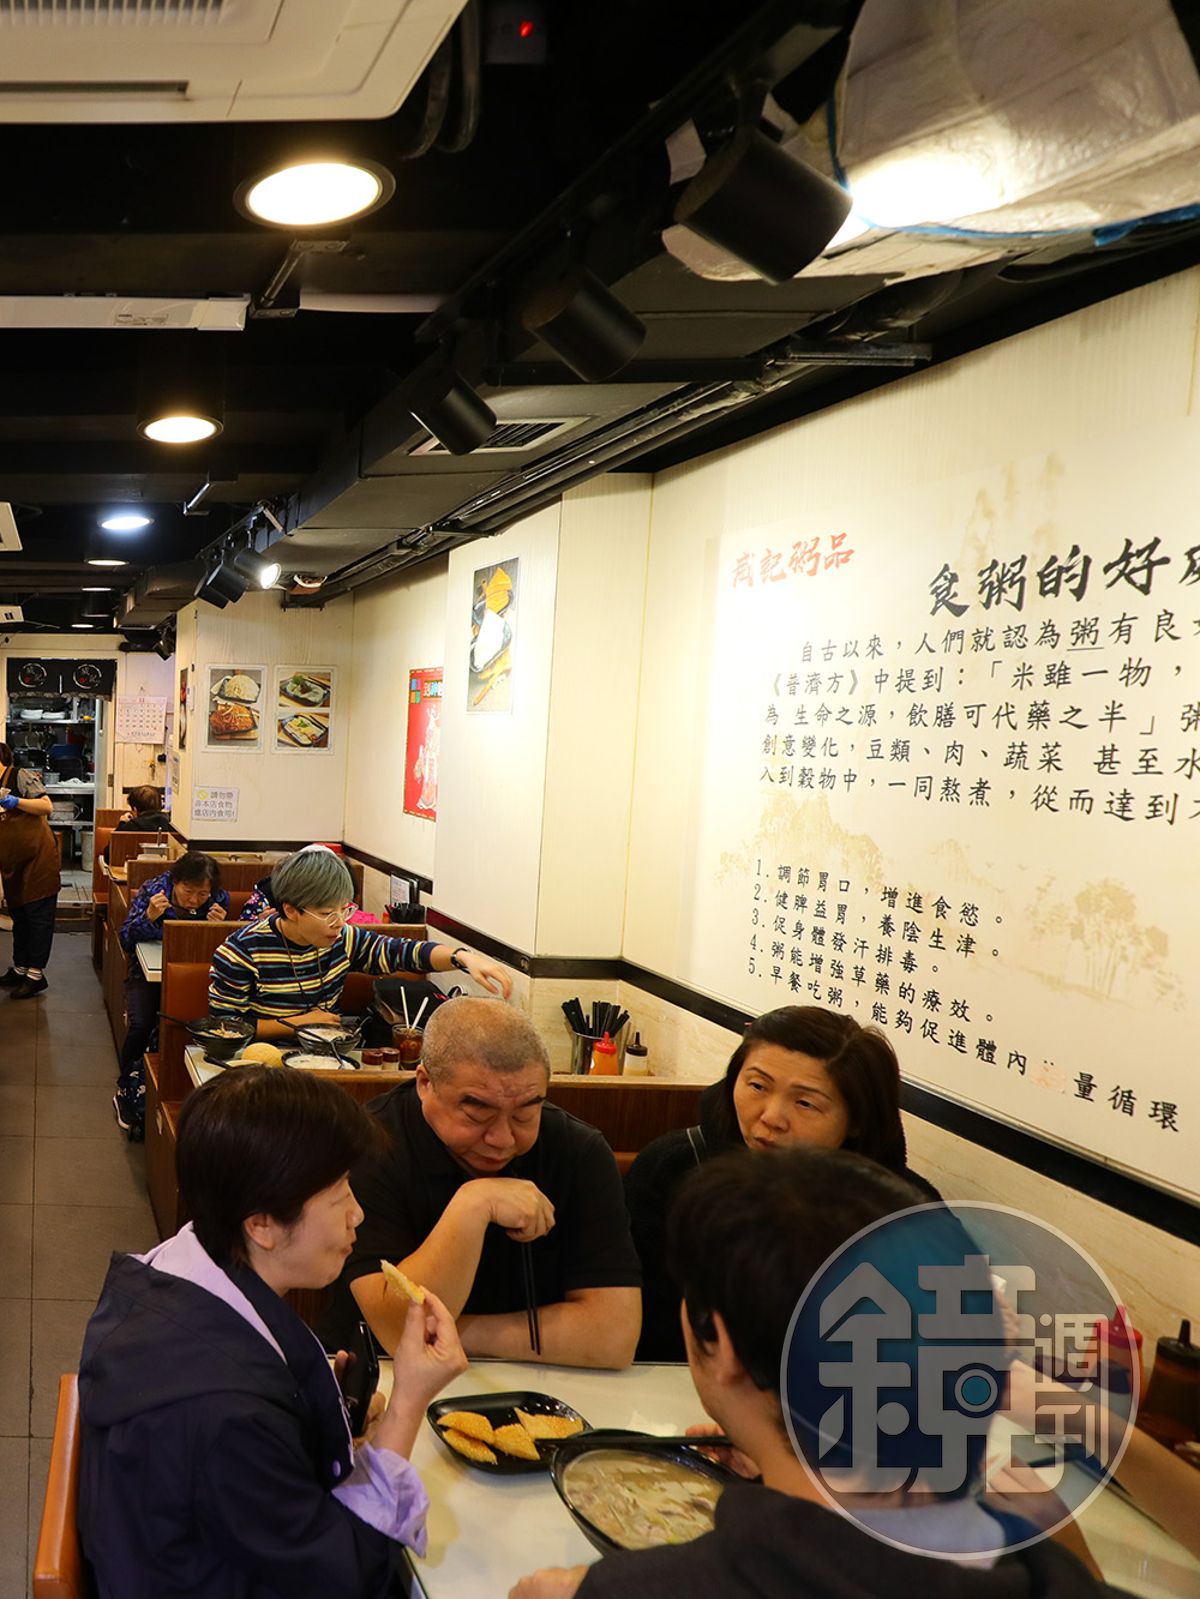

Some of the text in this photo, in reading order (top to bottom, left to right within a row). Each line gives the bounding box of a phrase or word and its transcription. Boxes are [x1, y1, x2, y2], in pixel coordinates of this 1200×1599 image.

[801, 609, 1200, 663] 自古以來，人們就認為粥有良
[760, 765, 1200, 826] 入到穀物中，一同熬煮，從而達到
